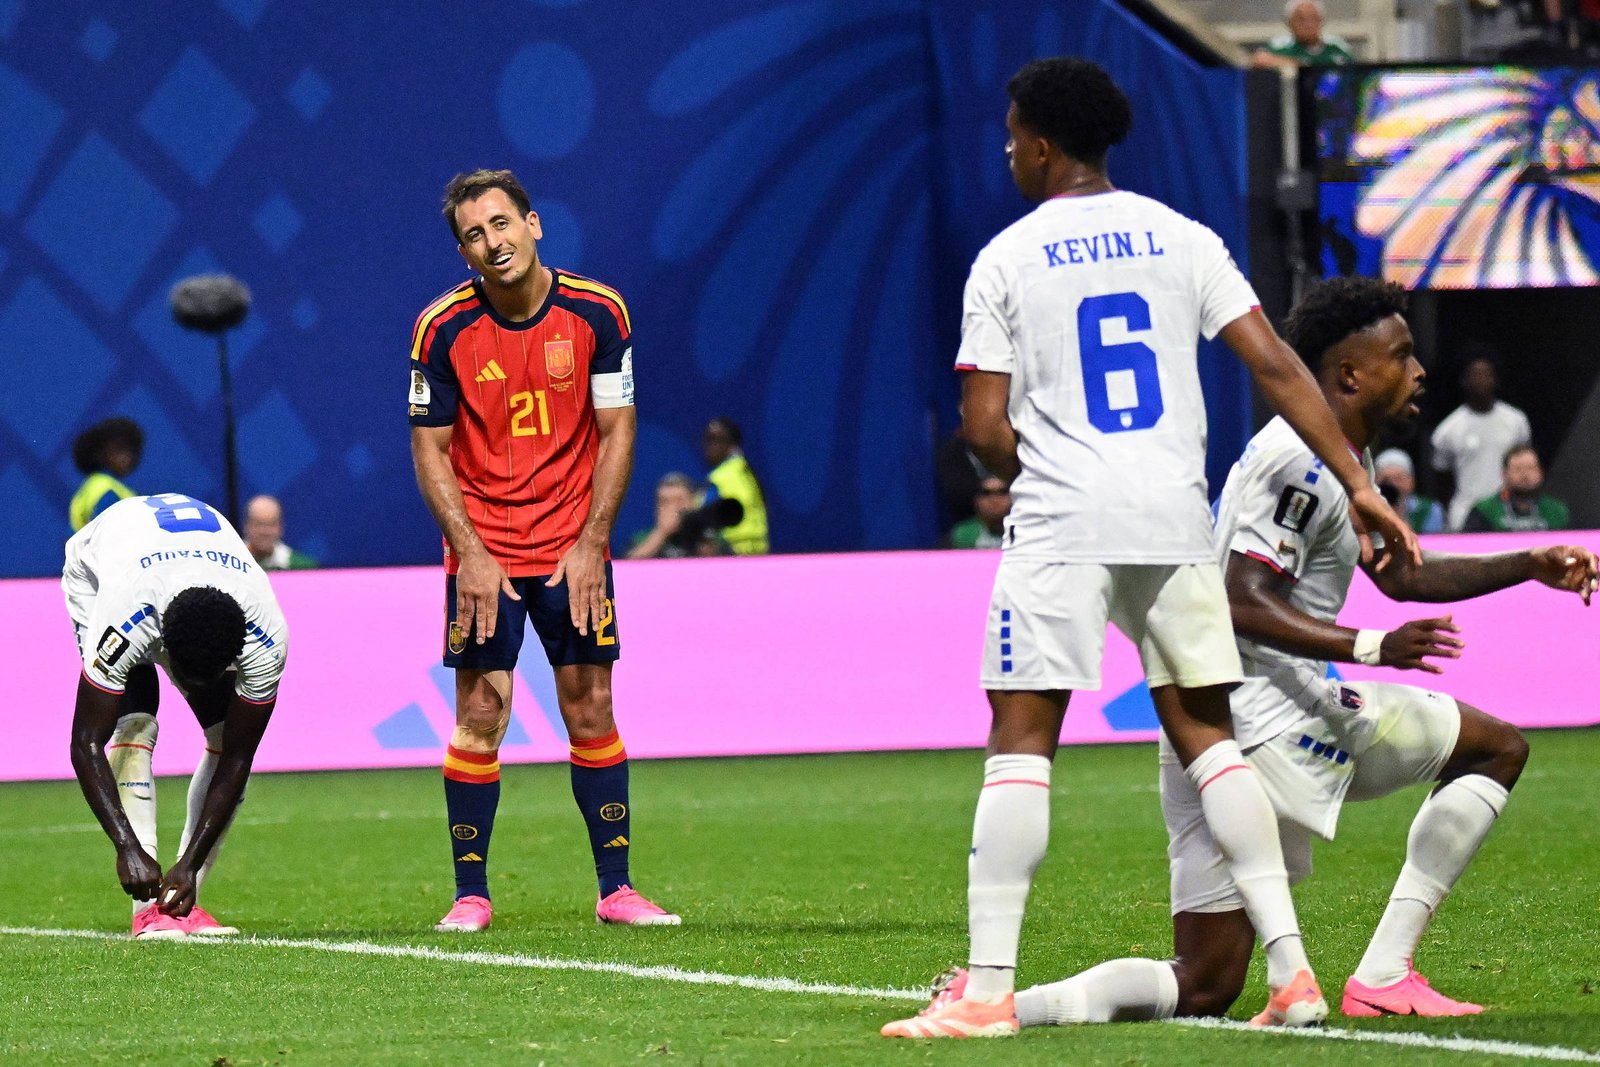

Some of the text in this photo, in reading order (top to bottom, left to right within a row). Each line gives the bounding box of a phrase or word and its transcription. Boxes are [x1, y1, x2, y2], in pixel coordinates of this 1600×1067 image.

[1077, 291, 1165, 434] 6
[509, 390, 551, 438] 21
[142, 493, 222, 533] 8
[596, 598, 615, 646] 2
